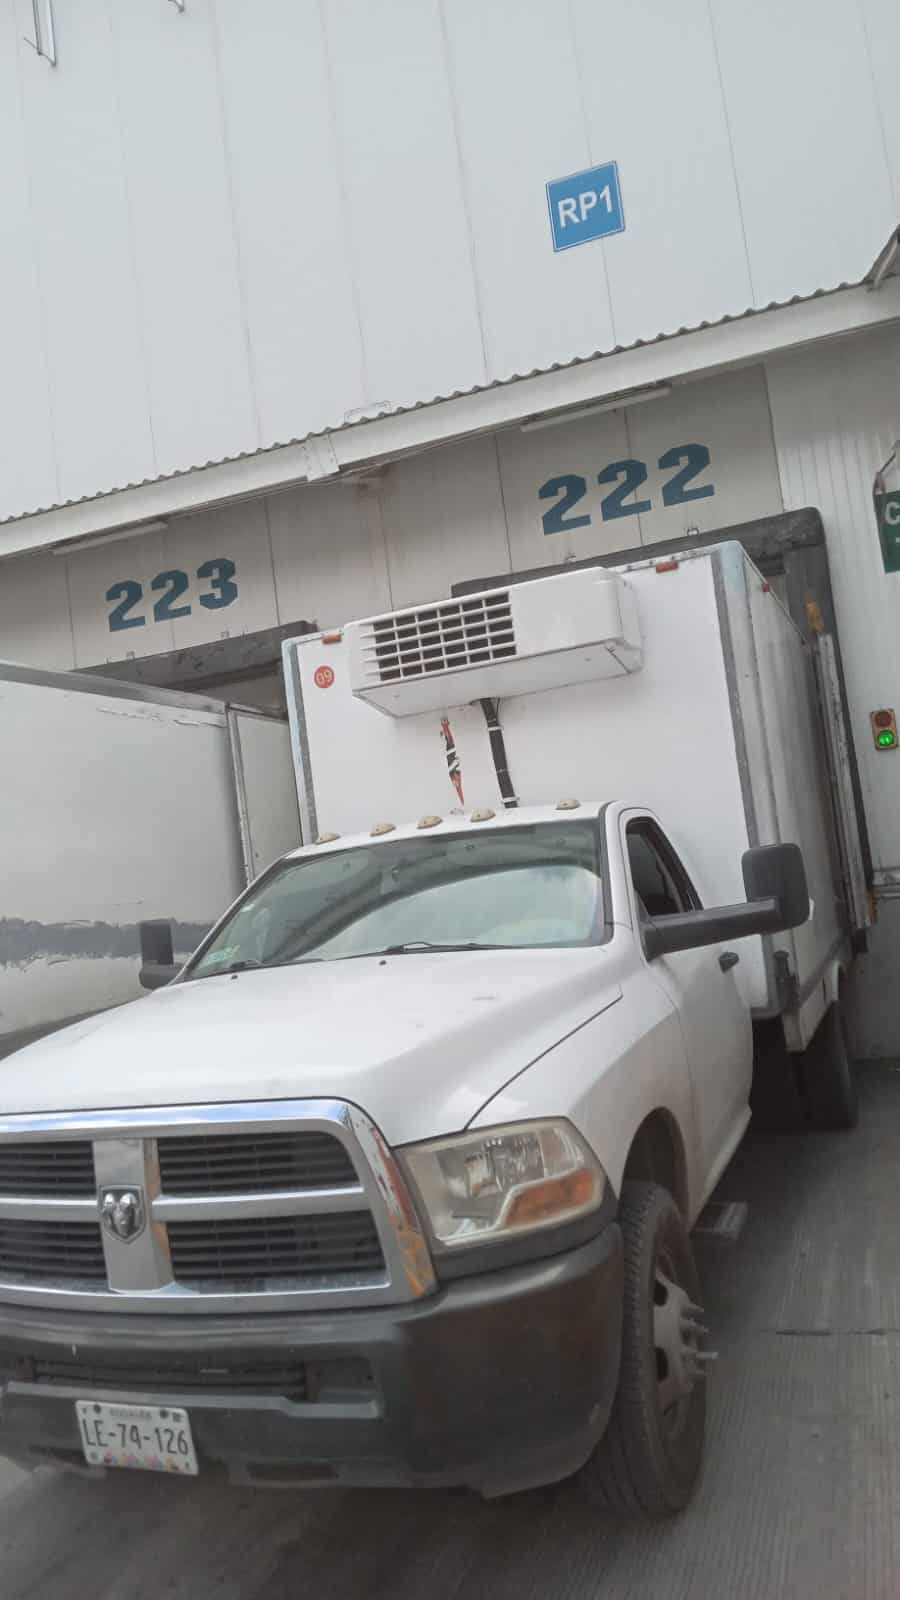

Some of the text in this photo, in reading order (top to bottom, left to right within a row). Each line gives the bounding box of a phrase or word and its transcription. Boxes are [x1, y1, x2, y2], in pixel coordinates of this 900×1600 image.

[557, 185, 613, 229] RP1
[538, 443, 715, 536] 222
[105, 558, 238, 632] 223
[83, 1419, 188, 1455] LE-74-126
